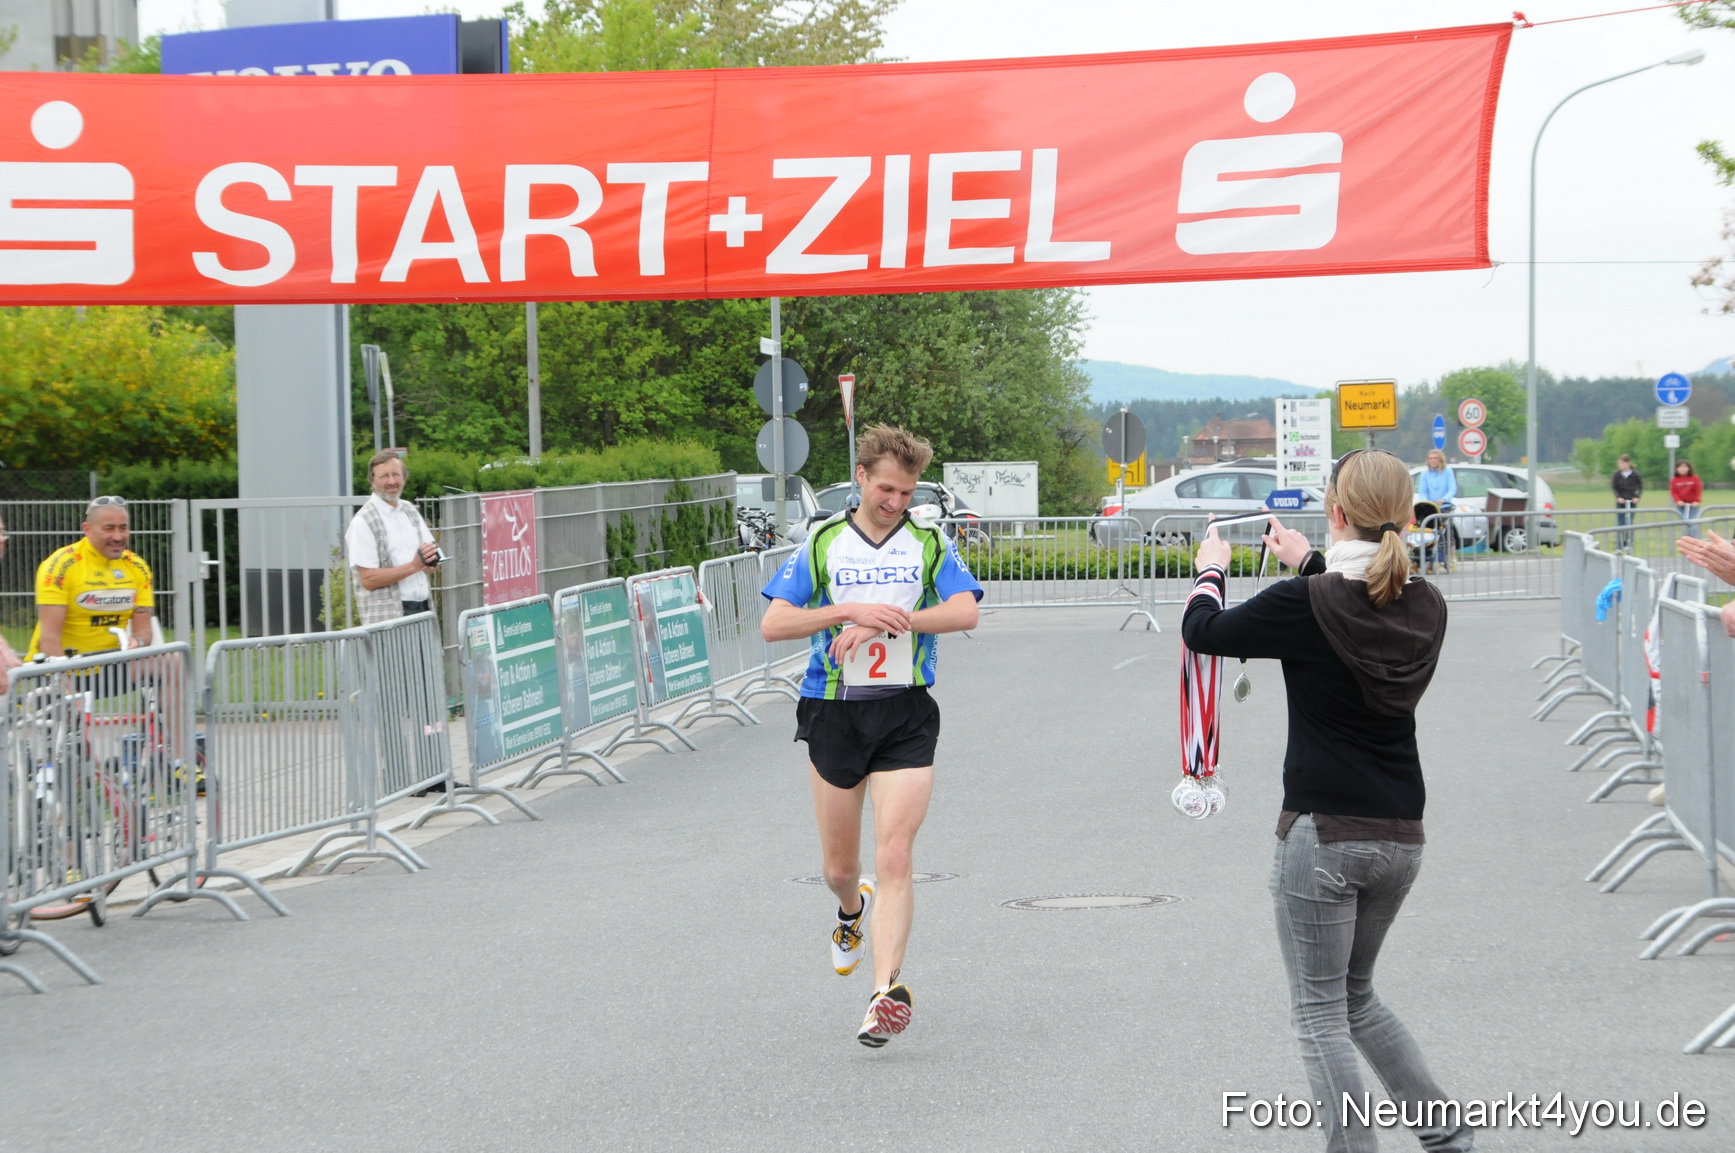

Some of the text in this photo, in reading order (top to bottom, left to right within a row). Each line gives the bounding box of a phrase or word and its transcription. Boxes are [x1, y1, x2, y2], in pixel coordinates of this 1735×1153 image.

[1345, 400, 1391, 410] Neumarkt
[1466, 406, 1480, 419] 60
[1273, 497, 1300, 507] VOLVO
[491, 545, 531, 581] ZEITLOS
[836, 566, 919, 586] BOCK
[80, 594, 130, 605] Mercatone
[660, 623, 668, 641] Fun
[671, 619, 684, 638] Action
[587, 642, 595, 660] Fun
[599, 637, 612, 657] Action
[868, 642, 887, 678] 2
[499, 667, 509, 687] Fun
[515, 661, 531, 683] Action
[531, 658, 538, 679] in
[502, 693, 523, 717] sicheren
